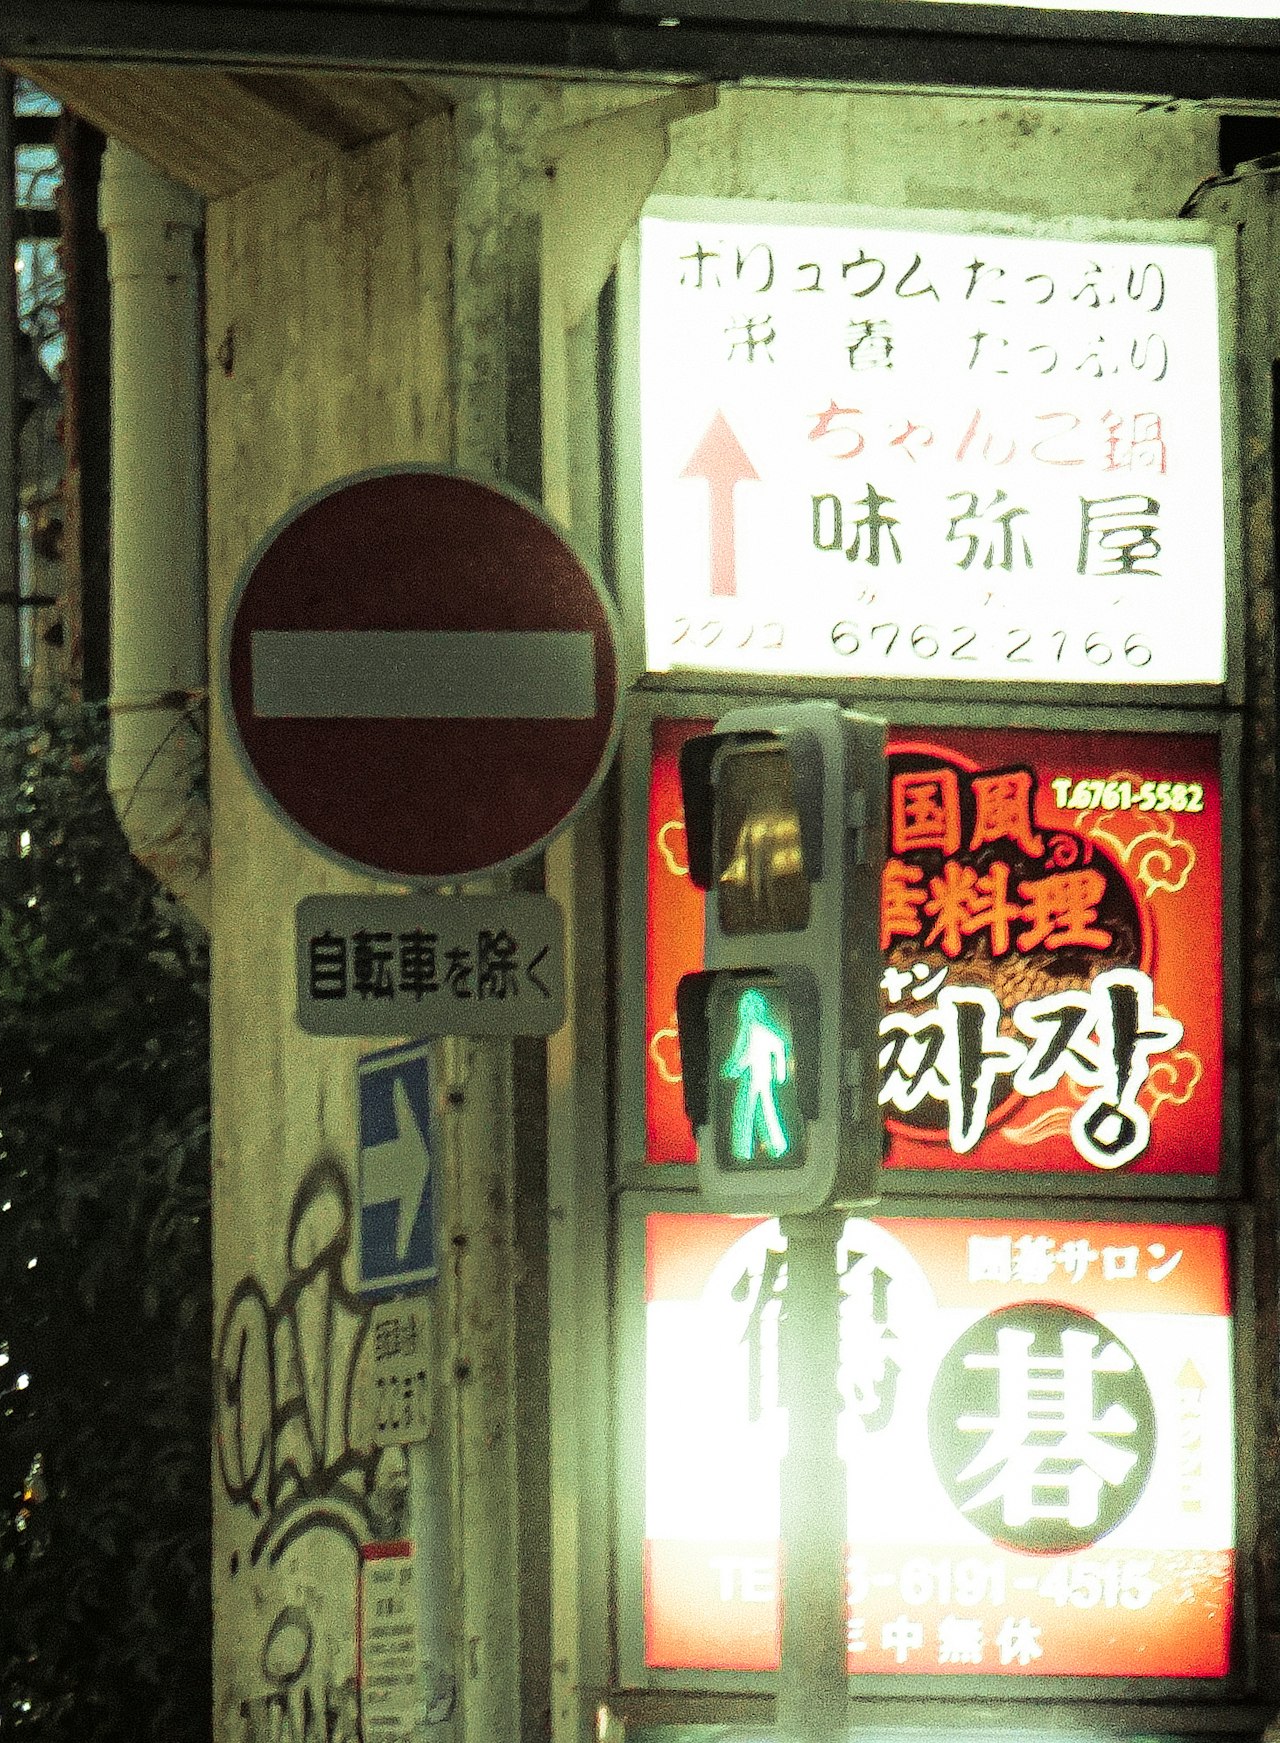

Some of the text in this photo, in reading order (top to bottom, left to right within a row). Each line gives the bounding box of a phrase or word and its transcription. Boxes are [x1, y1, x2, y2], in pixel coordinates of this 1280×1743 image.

[807, 398, 1169, 477] ちゃんこ鍋
[810, 482, 1164, 578] 味弥屋
[1051, 776, 1204, 812] T.6761-5582
[309, 926, 551, 1002] 自転車を除く
[955, 1326, 1138, 1528] 碁
